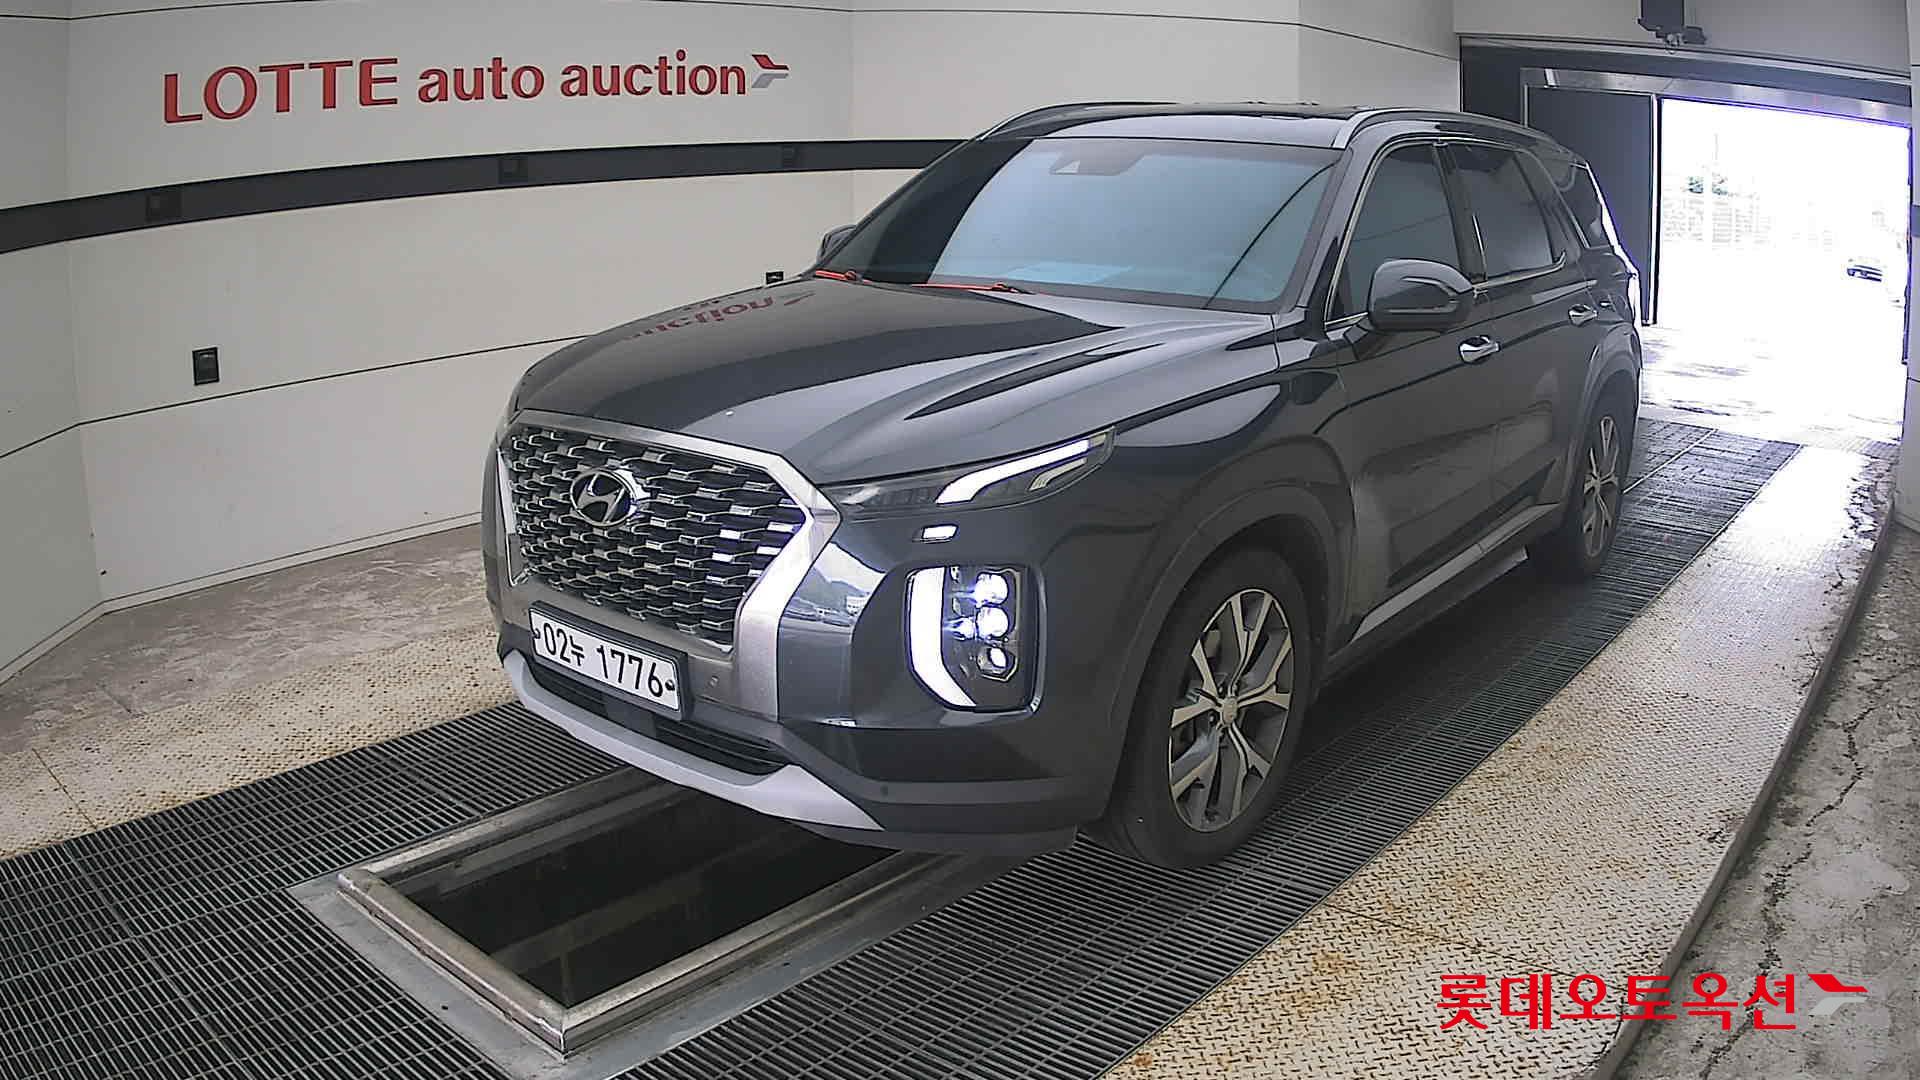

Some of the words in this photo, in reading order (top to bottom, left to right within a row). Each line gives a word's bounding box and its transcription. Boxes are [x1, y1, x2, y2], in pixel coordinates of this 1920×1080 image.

[163, 58, 399, 124] LOTTE
[417, 57, 545, 104] auto
[560, 48, 747, 98] auction
[543, 622, 585, 667] 02누
[596, 644, 664, 698] 1776
